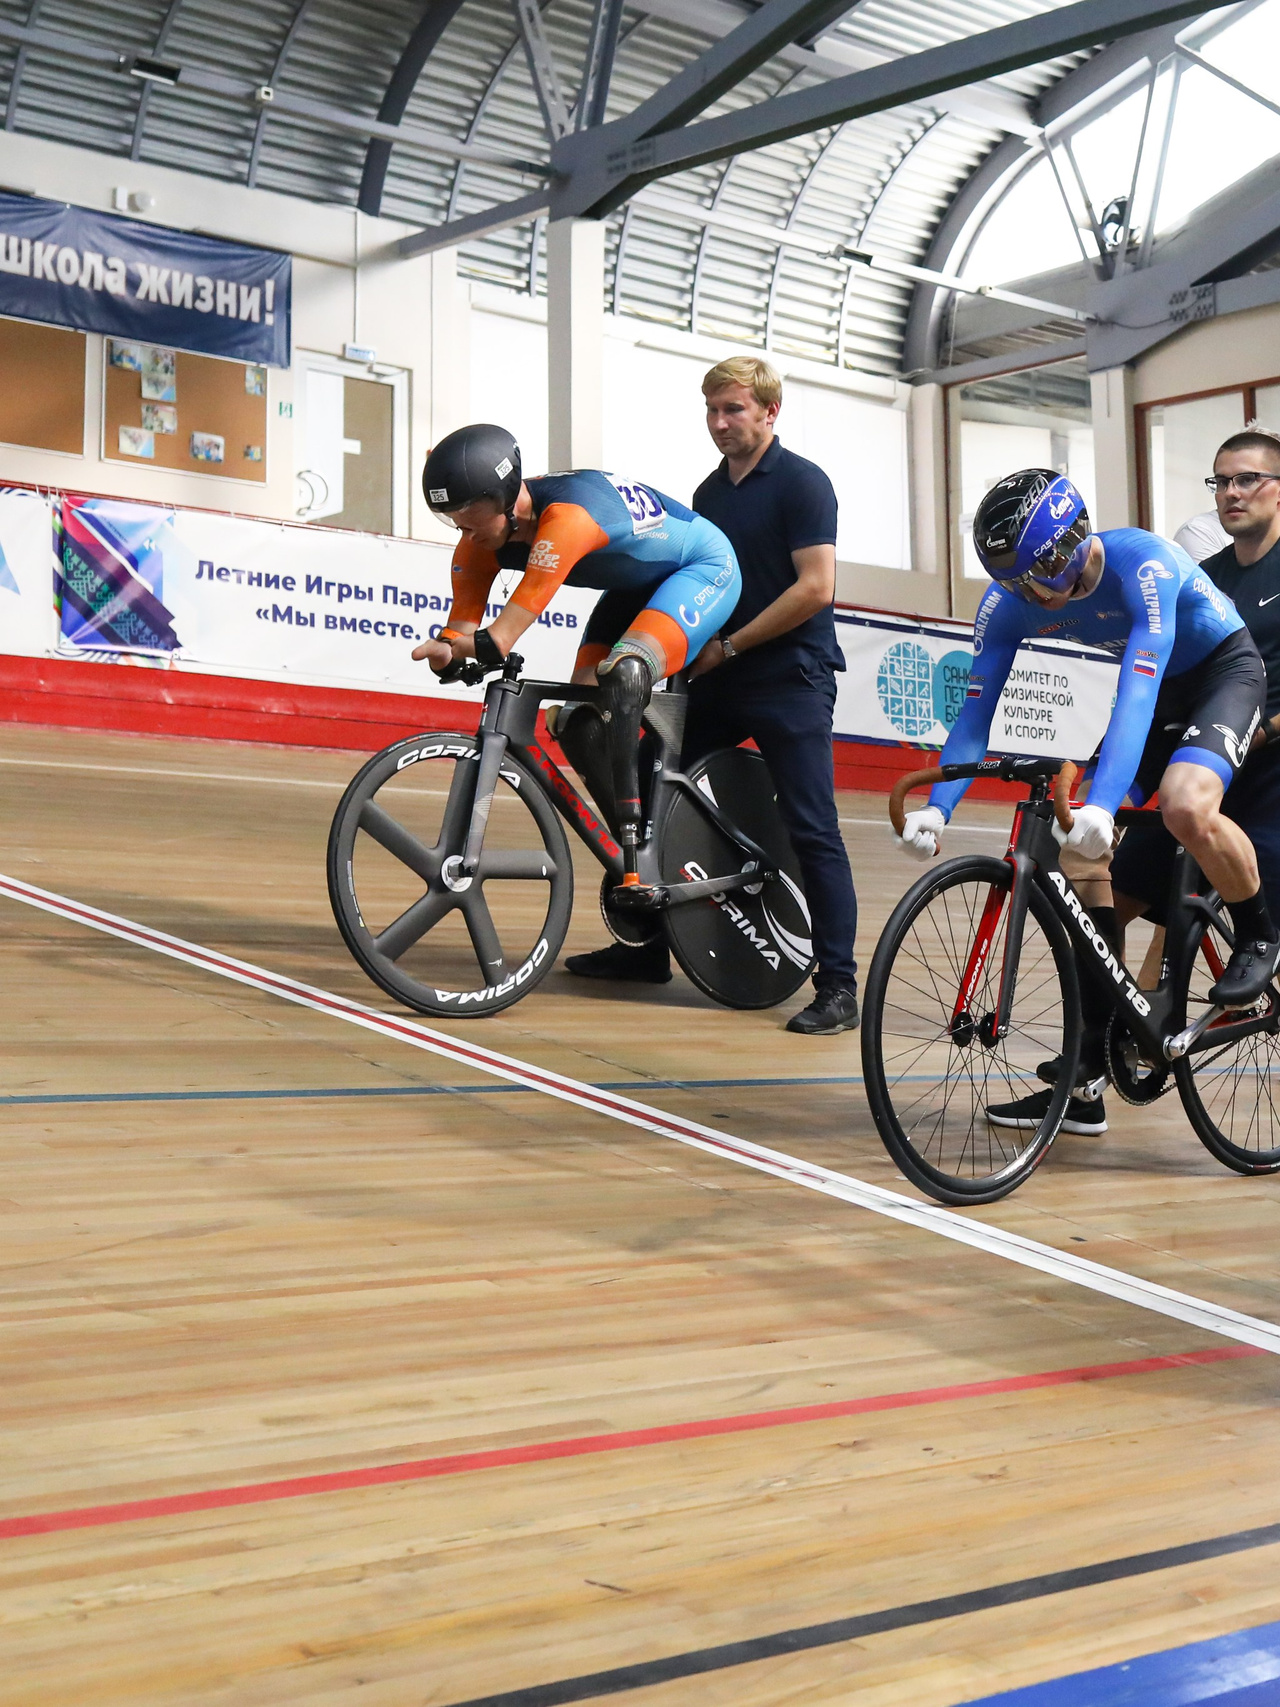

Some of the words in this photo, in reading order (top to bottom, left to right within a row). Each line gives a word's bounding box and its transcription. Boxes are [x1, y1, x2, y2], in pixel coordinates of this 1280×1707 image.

[136, 262, 275, 326] жизни!
[195, 560, 296, 591] Летние
[306, 574, 373, 603] Игры
[1193, 577, 1226, 621] COLNAGO
[256, 603, 315, 628] «Мы
[324, 614, 421, 640] вместе.
[974, 590, 1003, 641] GAZPROM
[1140, 578, 1162, 634] GAZPROM
[943, 665, 970, 682] САНК
[944, 685, 967, 704] ПЕТ
[1007, 668, 1051, 686] ОМИТЕТ
[1053, 674, 1069, 688] ПО
[1002, 686, 1074, 708] ФИЗИЧЕСКОЙ
[1003, 704, 1053, 723] КУЛЬТУРЕ
[1004, 724, 1013, 737] И
[1015, 724, 1056, 742] СПОРТУ
[396, 744, 521, 789] CORIA
[526, 745, 599, 832] ARGON
[597, 829, 621, 859] 18
[1047, 871, 1126, 985] ARGON
[1125, 980, 1152, 1017] 18
[434, 938, 549, 1005] CORIMA
